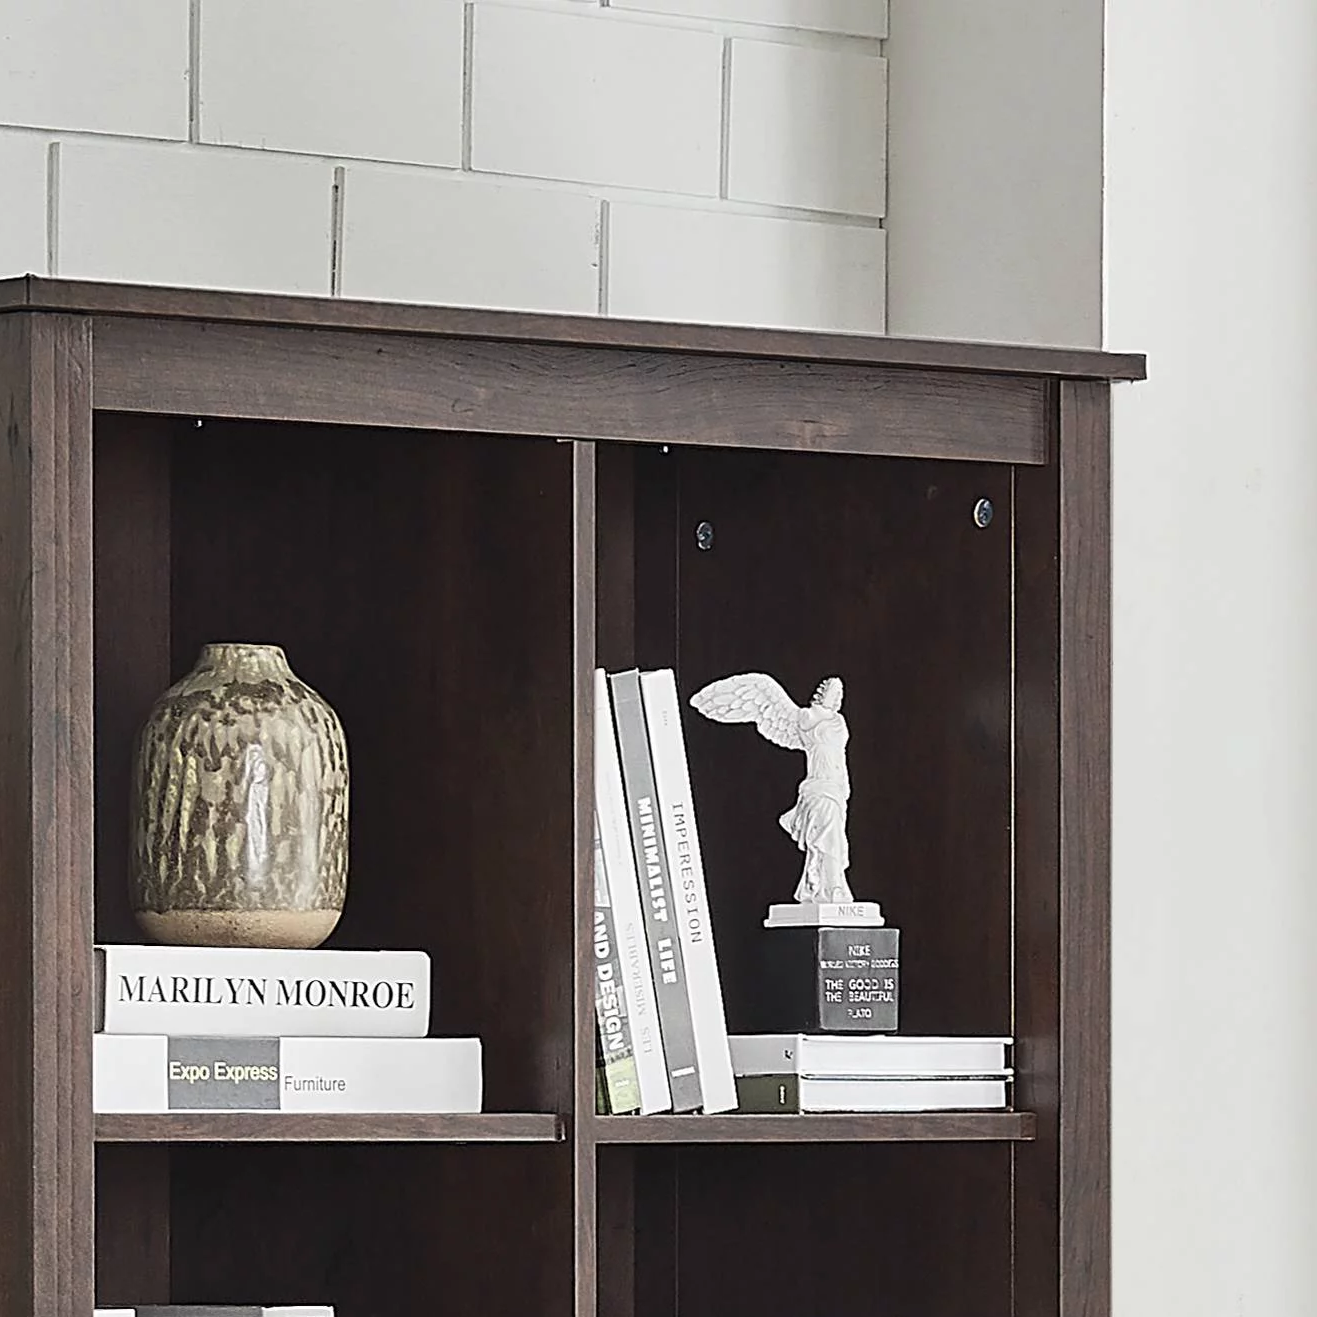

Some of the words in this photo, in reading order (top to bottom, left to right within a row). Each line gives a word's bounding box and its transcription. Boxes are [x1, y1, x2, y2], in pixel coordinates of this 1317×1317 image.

[637, 796, 669, 923] MINIMALIST
[657, 937, 678, 985] LIFE
[671, 801, 703, 945] IMPERESSION
[837, 904, 865, 918] NIKE
[594, 911, 610, 960] AND
[118, 974, 268, 1006] MARILYN
[275, 978, 415, 1009] MONROE
[597, 963, 625, 1051] DESIGN
[168, 1060, 211, 1085] Expo
[213, 1060, 279, 1085] Express
[284, 1075, 347, 1092] Furniture
